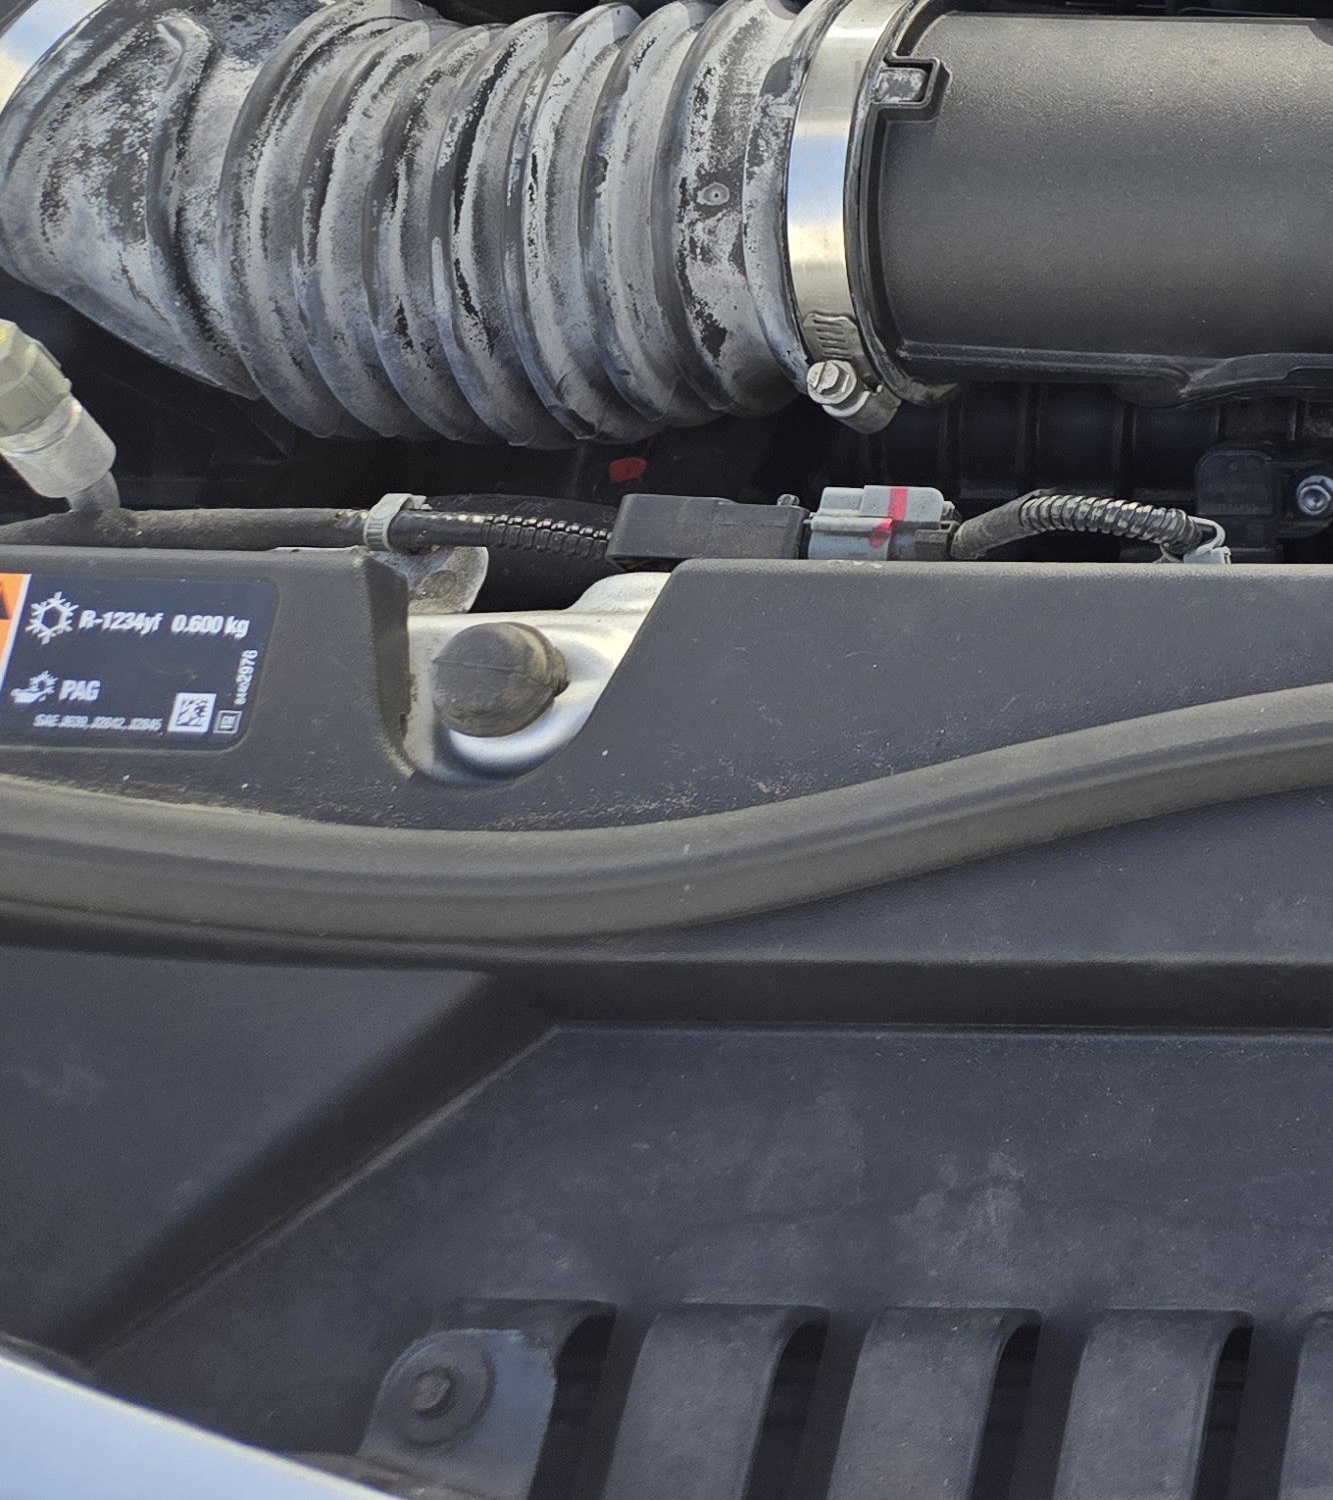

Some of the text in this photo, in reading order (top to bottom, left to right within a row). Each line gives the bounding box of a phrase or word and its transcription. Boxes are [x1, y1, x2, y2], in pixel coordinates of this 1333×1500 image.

[78, 609, 250, 640] R-1234yf 0.600 kg
[58, 679, 101, 702] PAG
